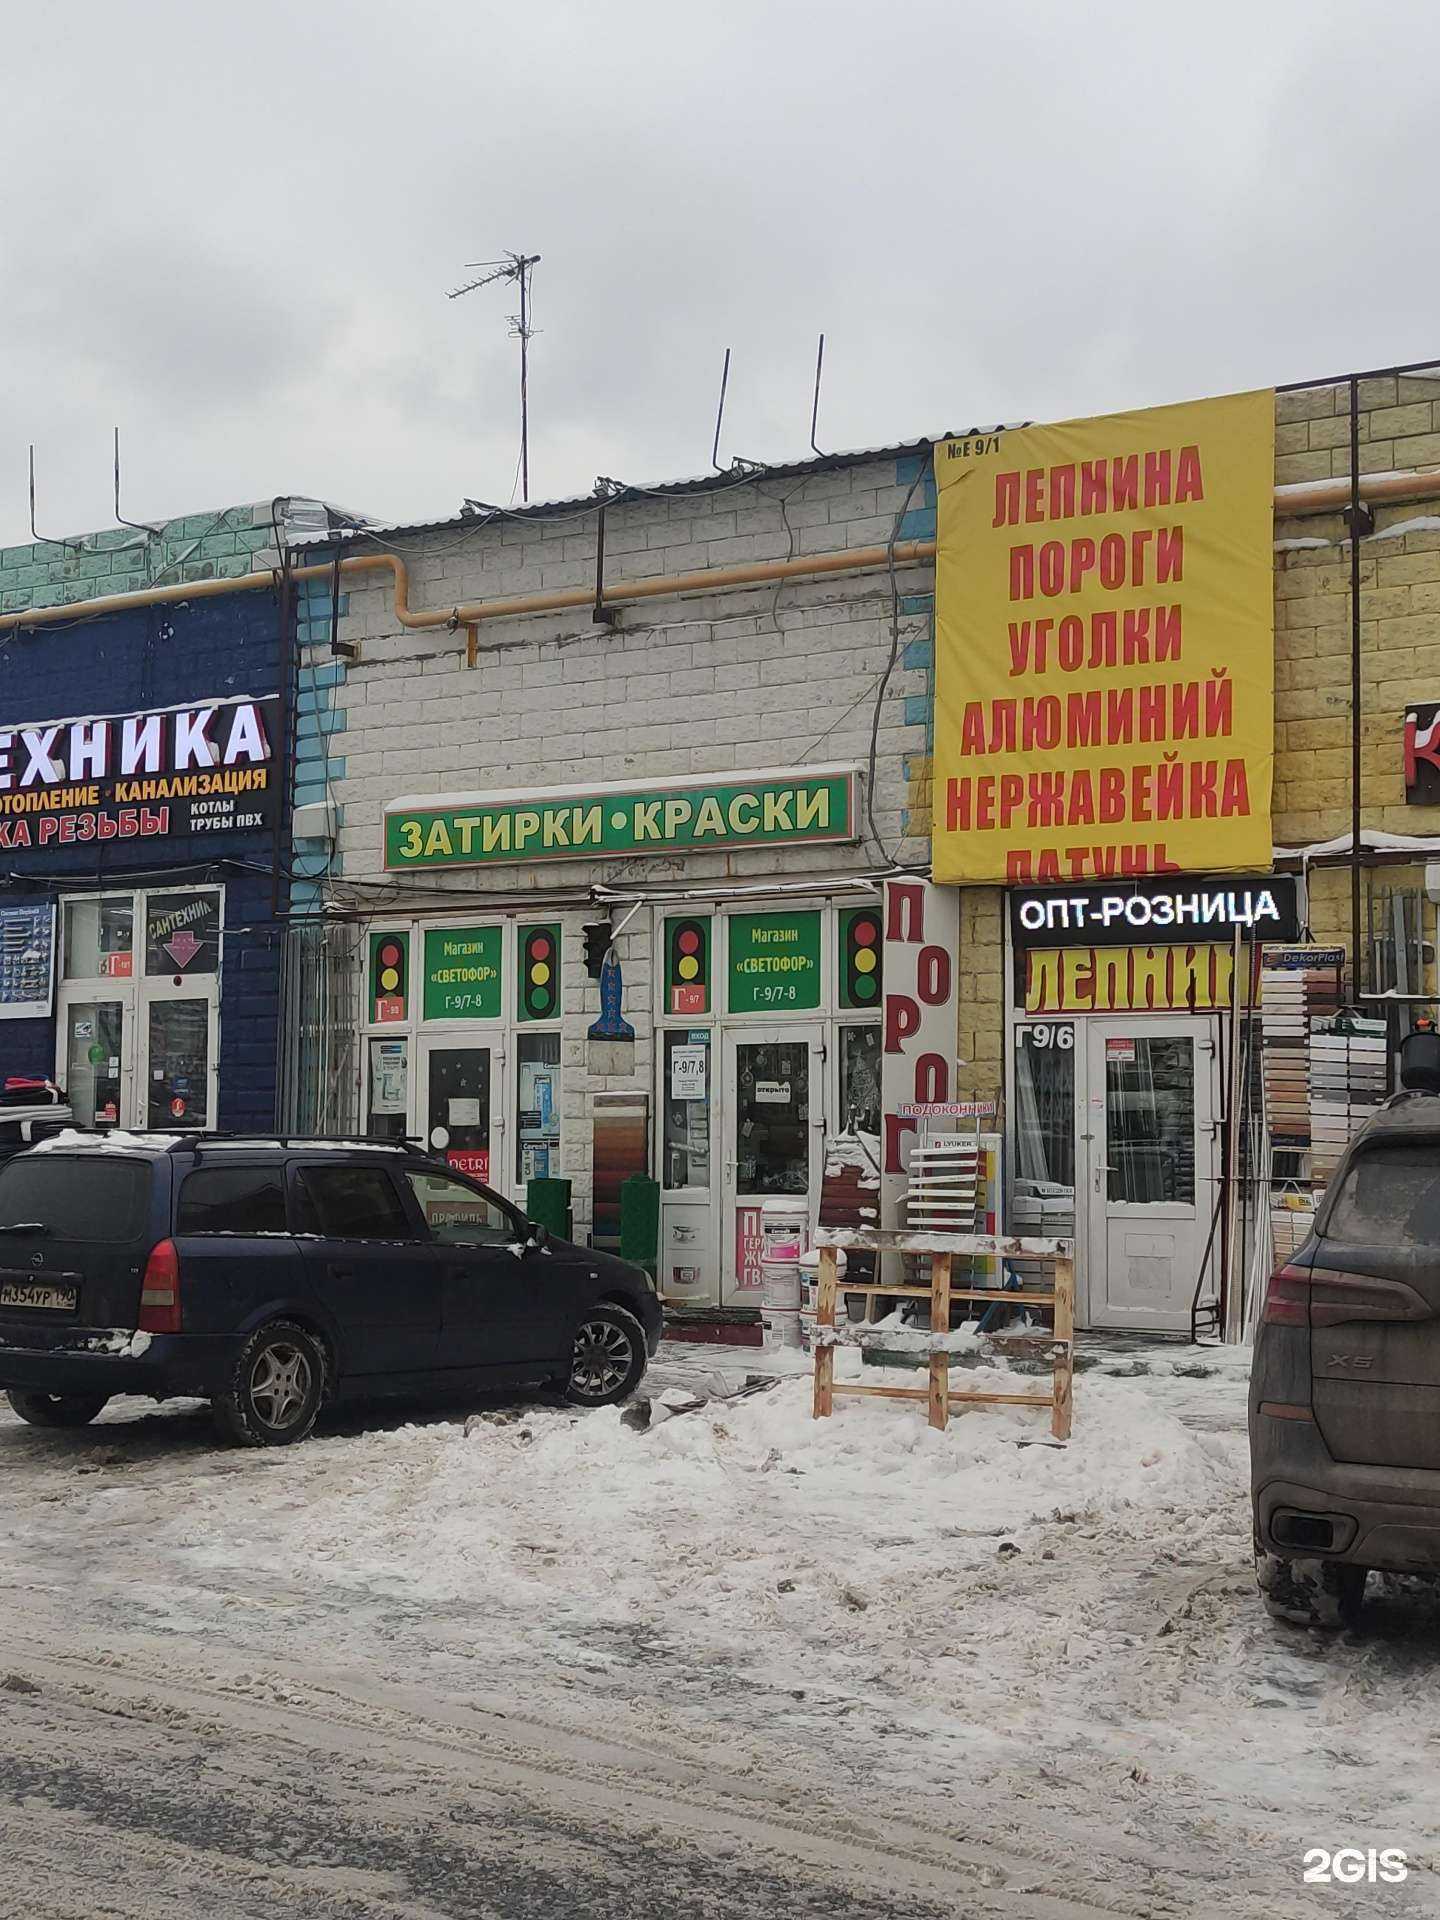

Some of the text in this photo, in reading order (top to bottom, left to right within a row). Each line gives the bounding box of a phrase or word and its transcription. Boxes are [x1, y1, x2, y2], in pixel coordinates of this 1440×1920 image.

[975, 436, 999, 456] 9/1
[992, 443, 1205, 528] ЛЕПНИНА
[1009, 525, 1184, 602] ПОРОГИ
[1008, 604, 1183, 678] УГОЛКИ
[960, 666, 1234, 757] АЛЮМИНИЙ
[0, 768, 268, 815] ТОПЛЕНИЕ КАНАЛИЗАЦИЯ
[945, 750, 1251, 833] НЕРЖАВЕЙКА
[190, 799, 235, 816] КОТЛЫ
[38, 806, 170, 845] РЕЗЬБЫ
[190, 812, 263, 832] ТРУБЫ ПВХ
[398, 787, 830, 859] ЗАТИРКИ КРАСКИ
[1019, 890, 1281, 930] ОПТ-РОЗНИЦА
[752, 928, 799, 944] Магазин
[444, 941, 484, 957] Магазин
[431, 966, 498, 984] «СВЕТОФОР»
[736, 956, 814, 974] «СВЕТОФОР»
[445, 994, 483, 1010] Г-9/7-8
[753, 986, 797, 1003] Г-9/7-8
[1015, 1024, 1074, 1050] Г9/6
[673, 1060, 705, 1076] Г-9/7,8
[902, 1102, 993, 1118] ПОДОКОННИКИ
[1327, 1353, 1374, 1369] X5
